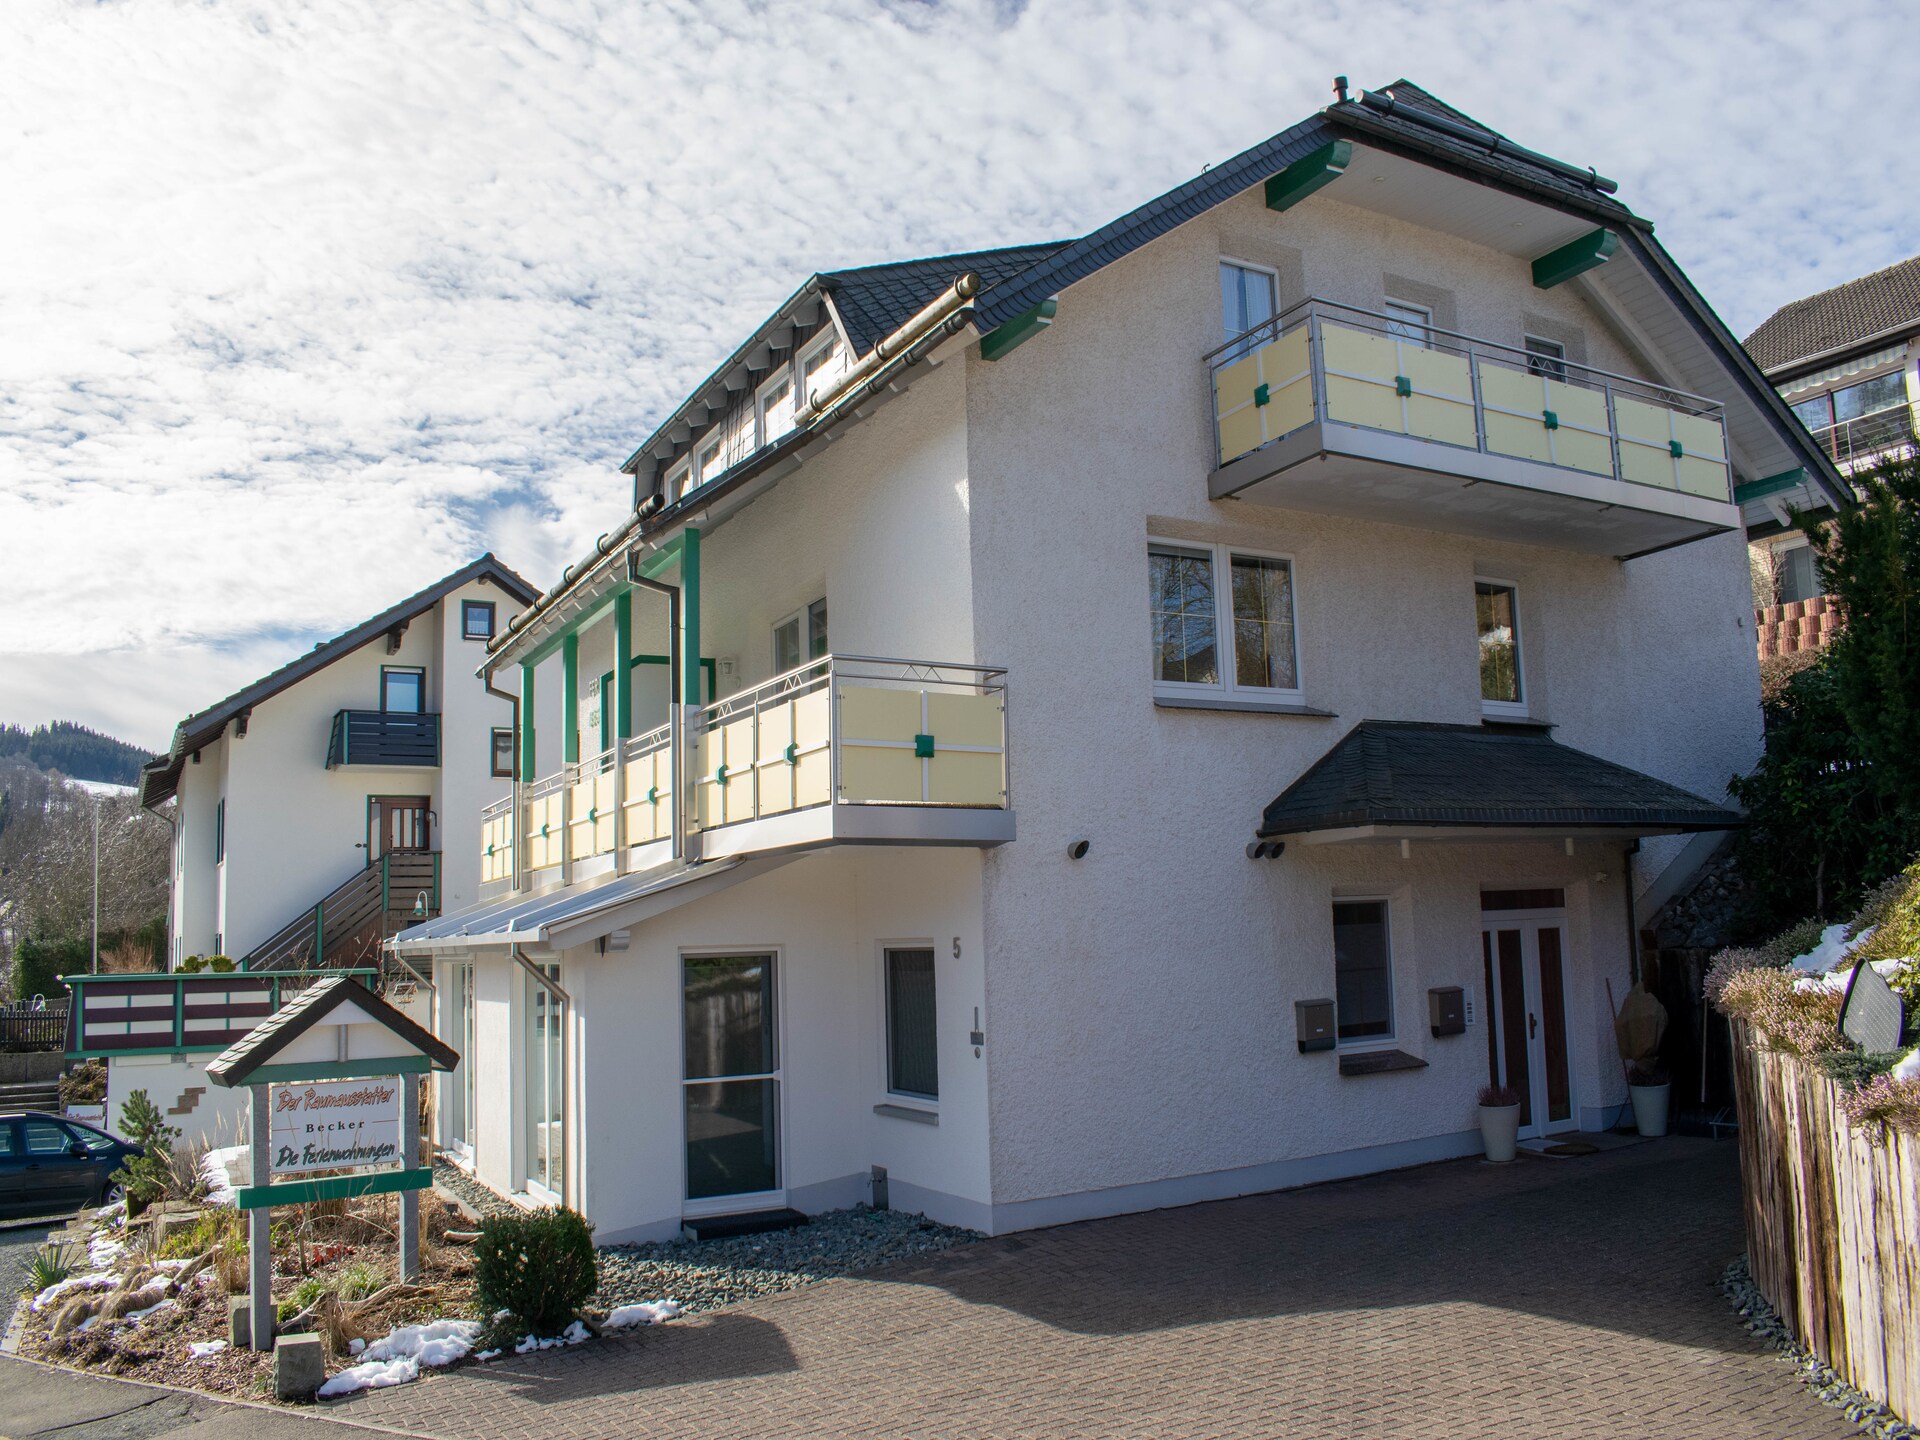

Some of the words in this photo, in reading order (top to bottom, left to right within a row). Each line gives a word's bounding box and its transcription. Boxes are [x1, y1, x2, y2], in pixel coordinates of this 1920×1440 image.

[953, 936, 961, 960] 5
[276, 1089, 302, 1112] Der
[304, 1085, 395, 1111] Raumausstatter
[306, 1120, 365, 1133] Becker
[275, 1145, 299, 1167] Die
[302, 1140, 395, 1166] Ferienwohnungen
